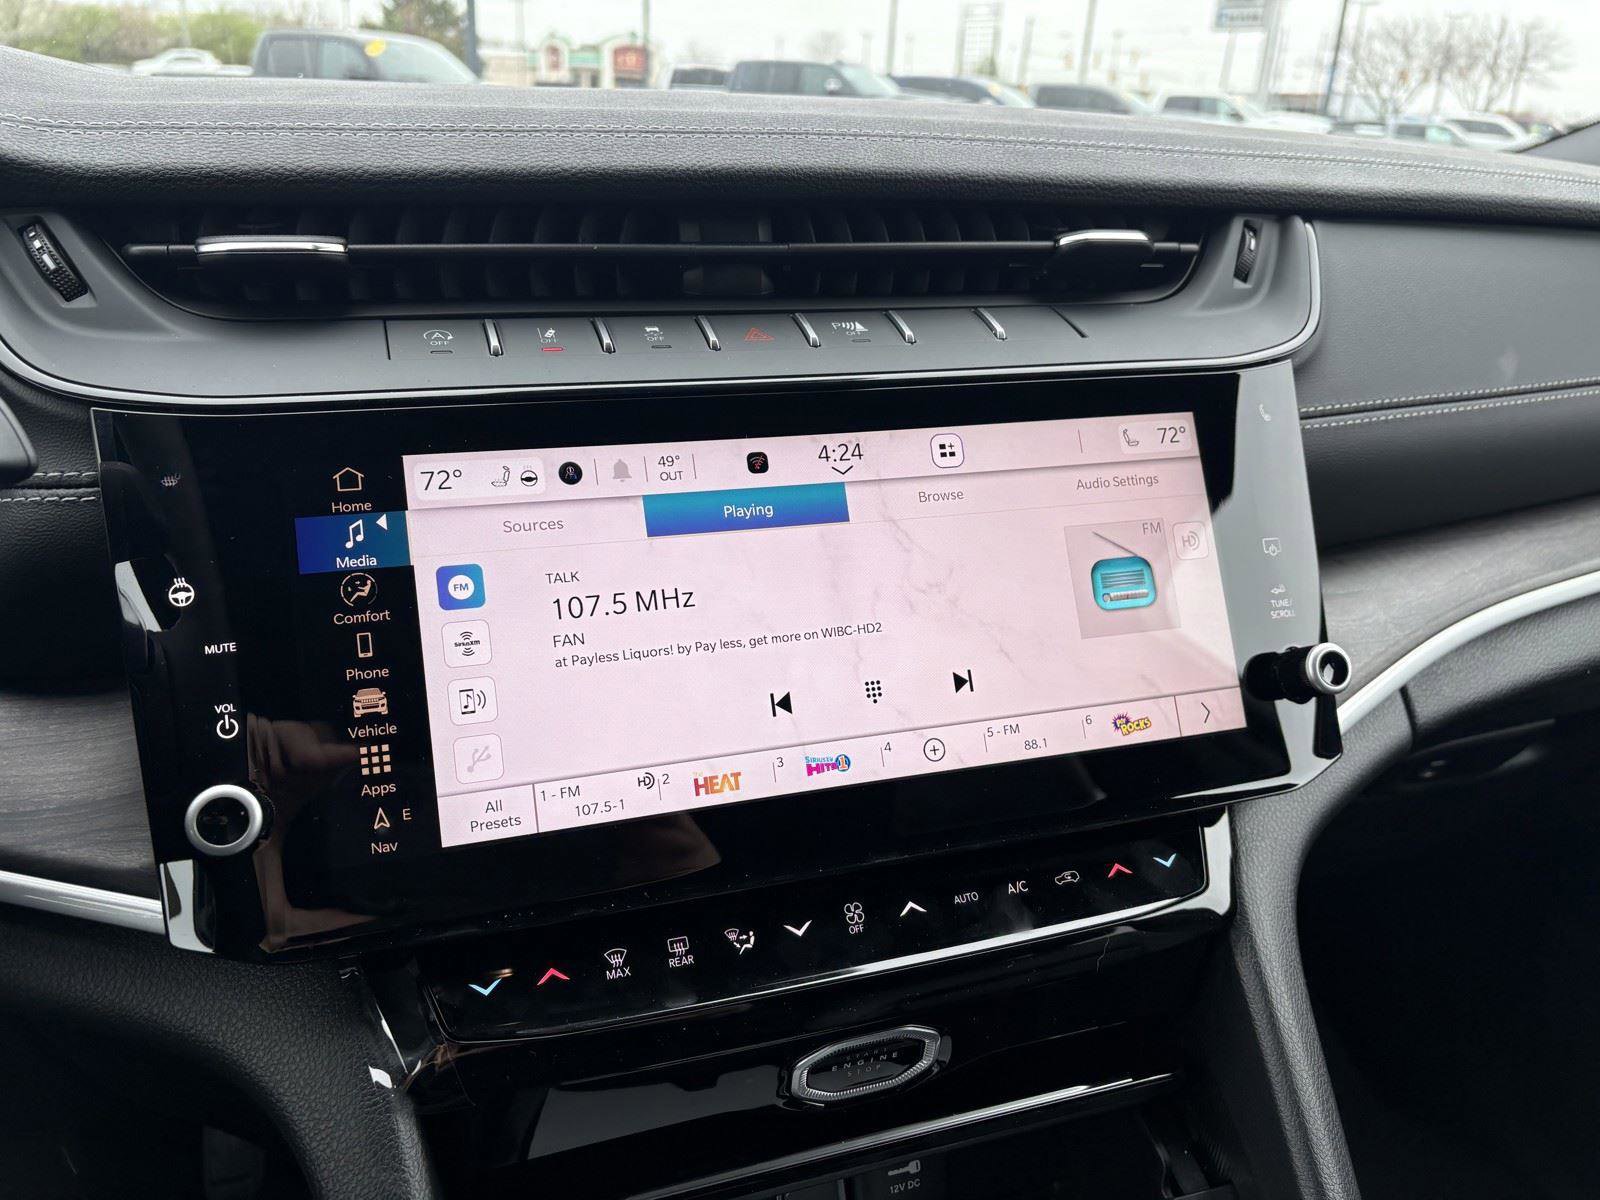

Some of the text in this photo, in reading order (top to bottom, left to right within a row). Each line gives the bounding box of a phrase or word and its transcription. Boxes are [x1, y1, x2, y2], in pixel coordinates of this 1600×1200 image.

[1156, 426, 1187, 445] 72°
[817, 442, 865, 463] 4:24
[657, 454, 681, 469] 49°
[419, 468, 463, 492] 72°
[659, 470, 684, 482] OUT
[1076, 473, 1160, 491] Audio Settings
[918, 488, 965, 503] Browse
[331, 500, 373, 514] Home
[723, 503, 775, 520] Playing
[502, 518, 565, 534] Sources
[1141, 521, 1163, 536] FM
[335, 555, 378, 569] Media
[545, 570, 581, 585] TALK
[453, 582, 470, 592] FM
[551, 586, 697, 621] 107.5 MHz
[333, 609, 391, 626] Comfort
[1270, 609, 1296, 619] SCROLL
[552, 632, 586, 648] FAN
[554, 621, 883, 668] at Payless Liquors! by Pay less, get more on WIBC-HD2
[204, 642, 237, 655] MUTE
[345, 667, 391, 681] Phone
[214, 703, 237, 714] VOL
[1085, 714, 1093, 725] 6
[1121, 717, 1152, 736] ROCKS
[347, 722, 398, 739] Vehicle
[986, 726, 994, 738] 5
[1003, 723, 1021, 736] FM
[884, 741, 892, 752] 4
[1023, 737, 1048, 751] 88.1
[776, 756, 784, 768] 3
[662, 773, 670, 785] 2
[693, 771, 742, 797] HEAT
[360, 782, 397, 798] Apps
[540, 789, 546, 802] 1
[559, 784, 582, 799] FM
[484, 799, 503, 814] All
[575, 798, 626, 818] 107.5-1
[402, 808, 412, 821] E
[470, 815, 522, 833] Presets
[370, 841, 399, 855] Nav
[1007, 880, 1029, 895] A/C
[953, 891, 980, 905] AUTO
[848, 923, 865, 935] OFF
[668, 954, 695, 969] REAR
[605, 966, 632, 981] MAX
[831, 1051, 898, 1072] ENGINE
[889, 1178, 921, 1194] 12V DC
